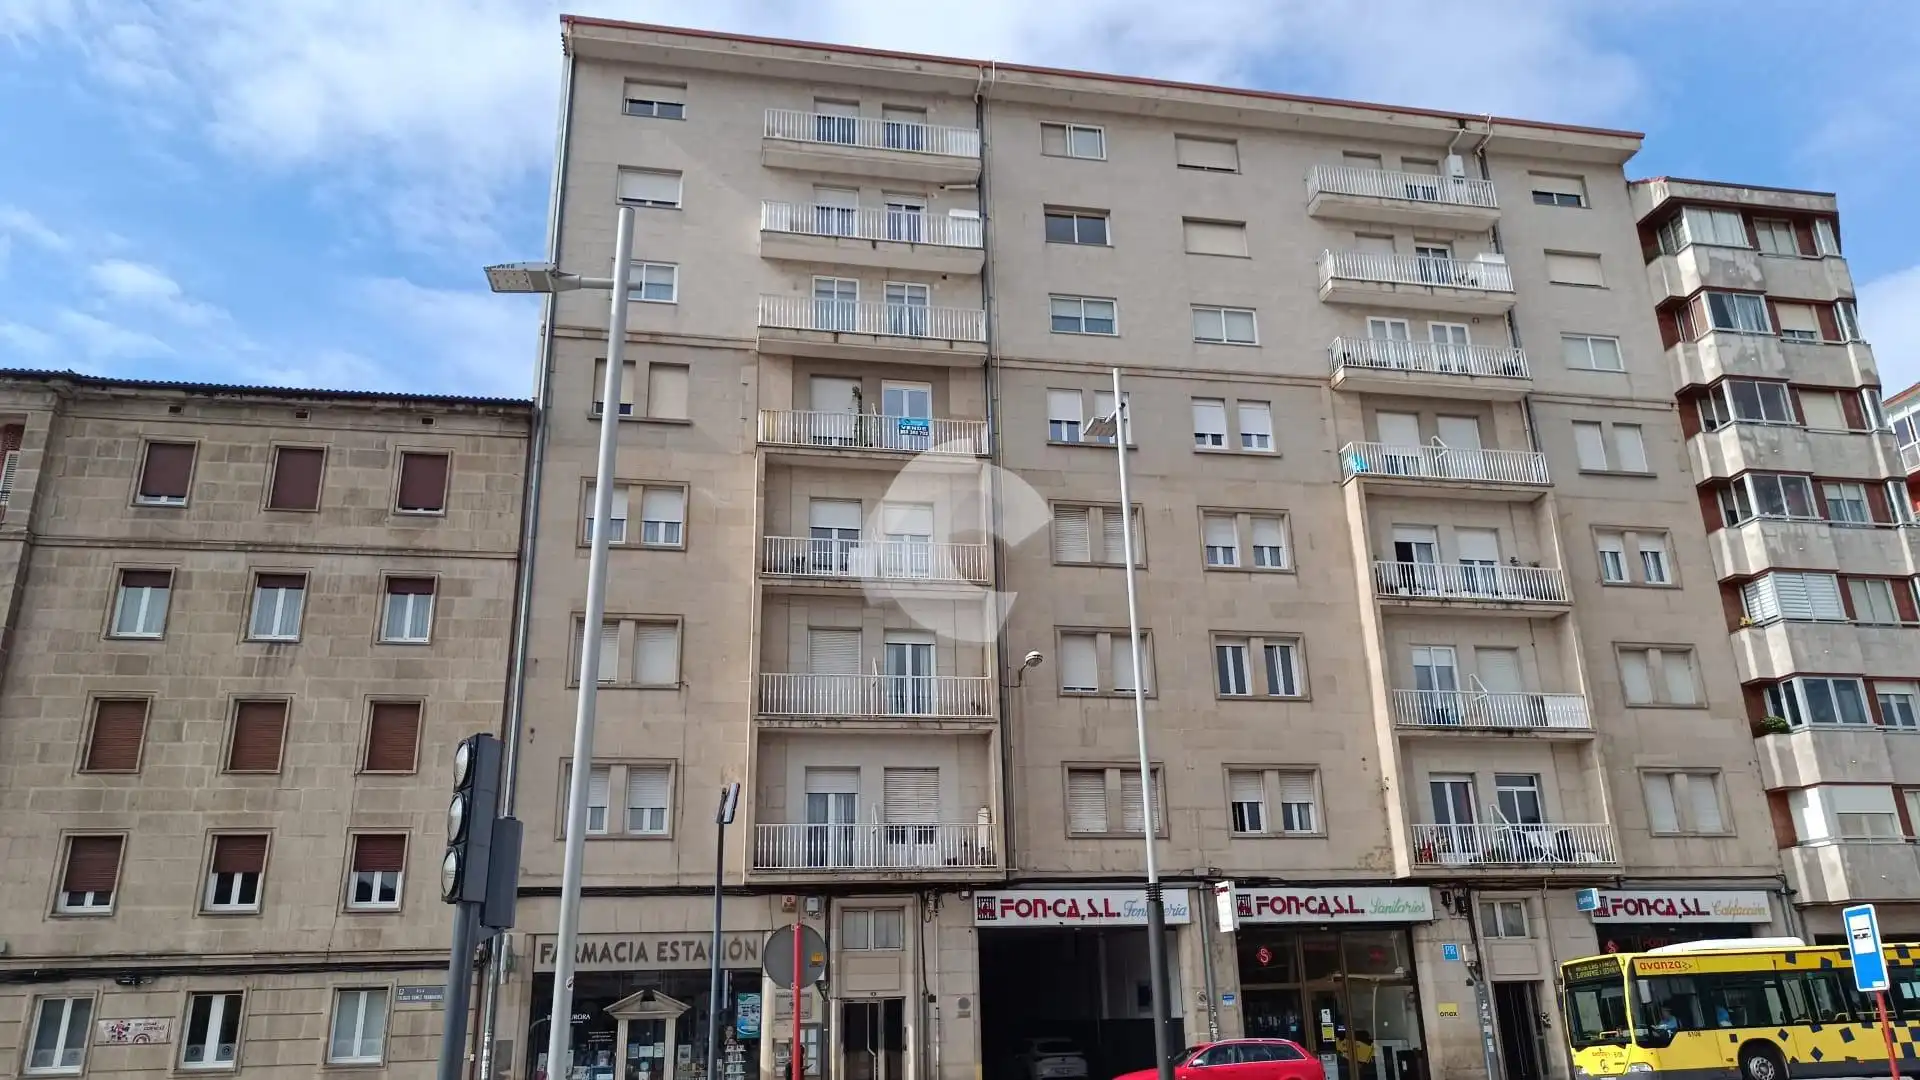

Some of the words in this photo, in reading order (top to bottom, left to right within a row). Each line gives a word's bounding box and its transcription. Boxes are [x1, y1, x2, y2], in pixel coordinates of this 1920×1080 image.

[1369, 895, 1425, 914] Sanitarios
[1445, 946, 1456, 954] PR
[1640, 961, 1681, 970] avanza
